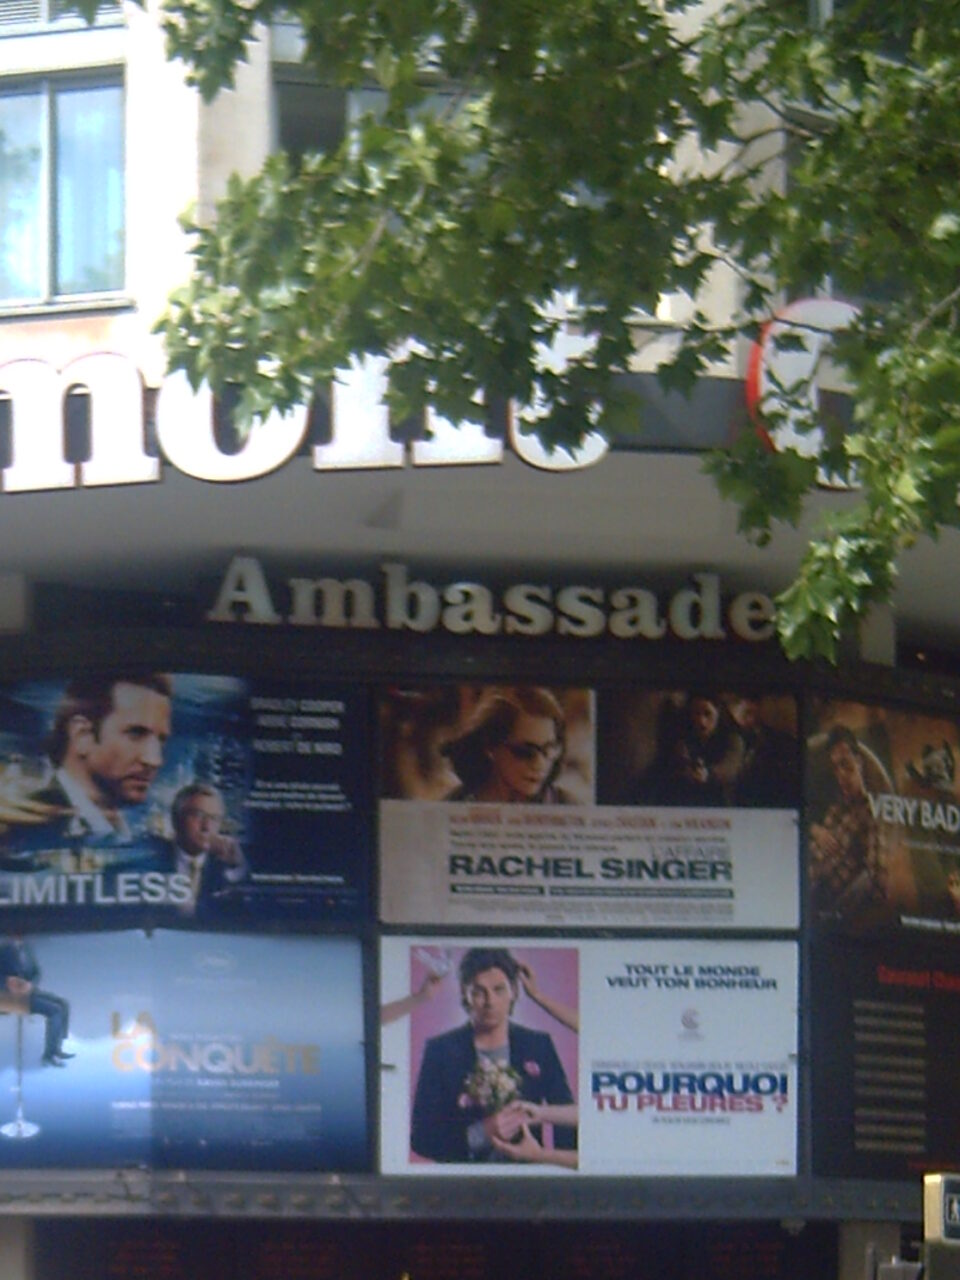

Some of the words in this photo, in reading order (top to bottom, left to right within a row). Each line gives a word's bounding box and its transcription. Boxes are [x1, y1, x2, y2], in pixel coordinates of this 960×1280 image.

[207, 555, 778, 642] Ambassade
[868, 792, 919, 826] VERY
[921, 801, 958, 833] BAD
[448, 853, 595, 880] RACHEL
[600, 857, 734, 881] SINGER
[606, 976, 651, 989] VEUT
[655, 977, 690, 990] TON
[693, 977, 778, 991] BONHEUR
[624, 964, 668, 977] TOUT
[673, 965, 694, 977] LE
[697, 965, 761, 977] MONDE
[591, 1070, 789, 1098] POURQUOI
[592, 1094, 629, 1113] TU
[636, 1094, 765, 1114] PLEURES
